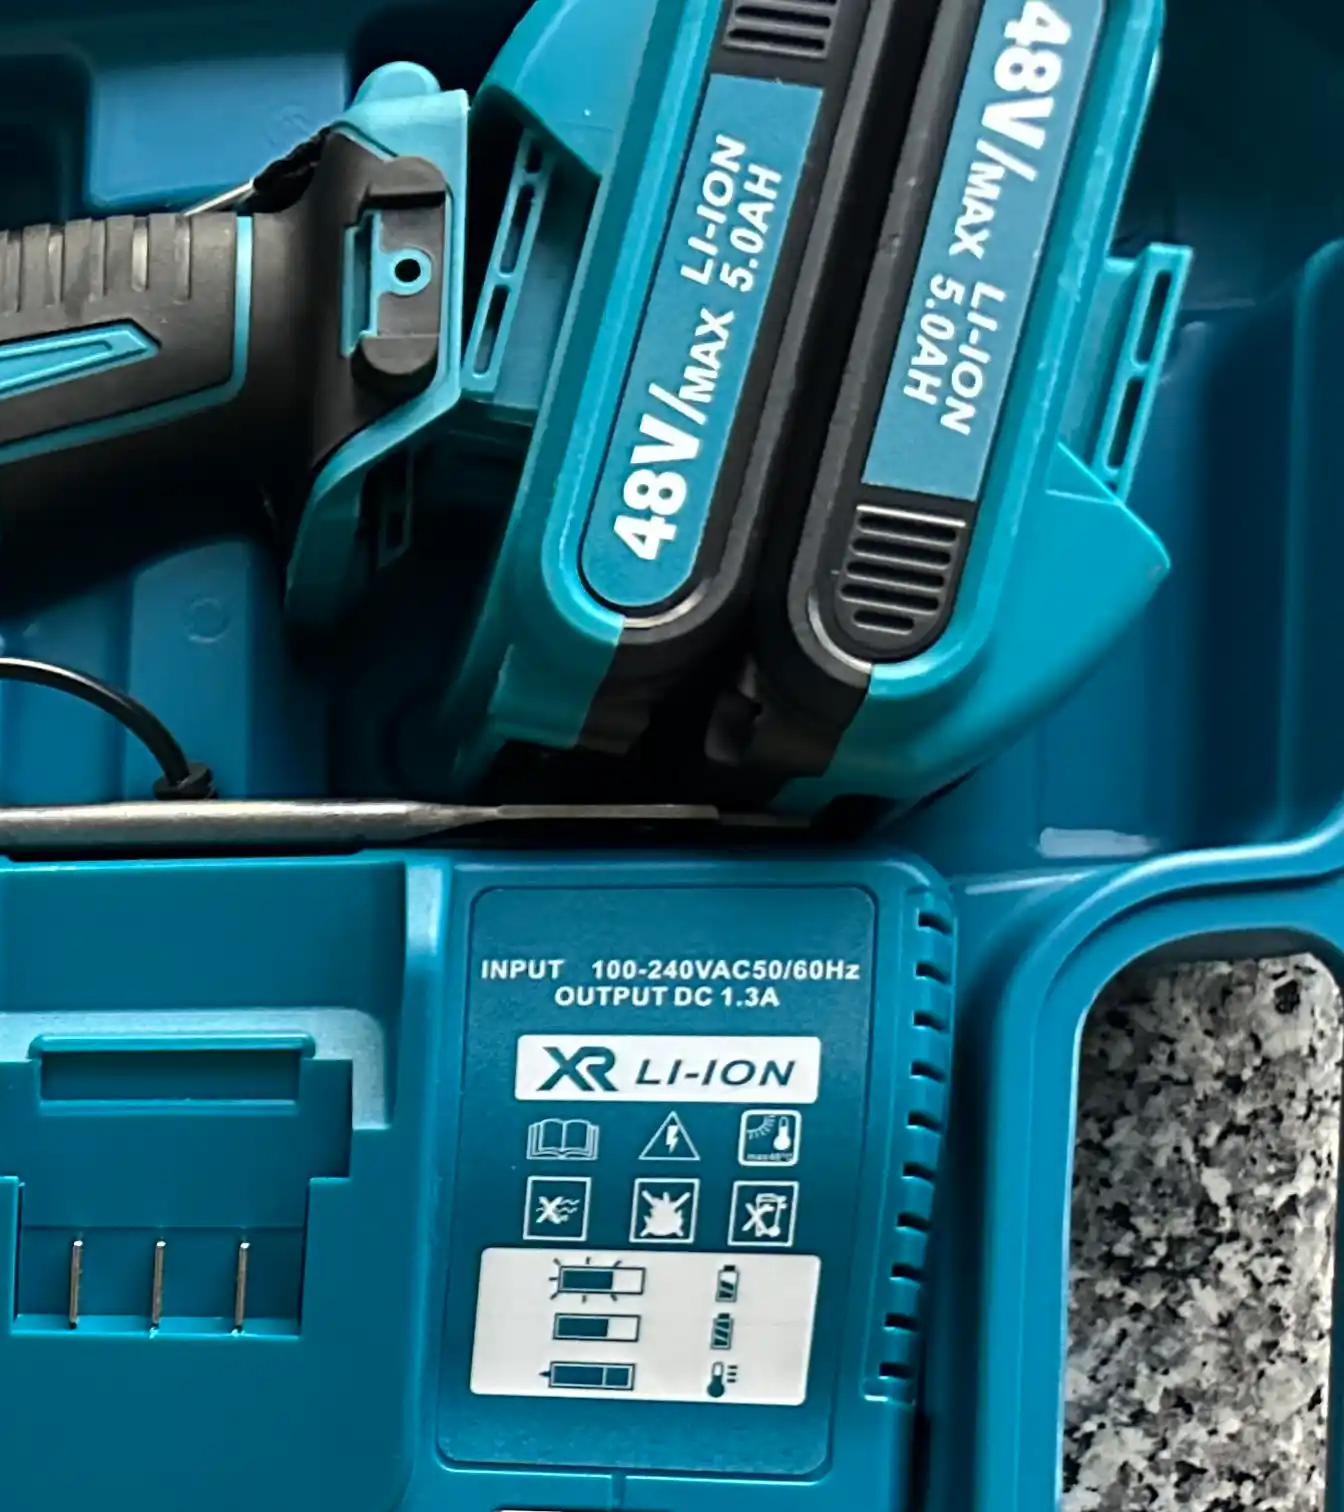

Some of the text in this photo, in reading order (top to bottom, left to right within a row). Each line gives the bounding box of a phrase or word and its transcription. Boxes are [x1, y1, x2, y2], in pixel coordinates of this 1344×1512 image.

[680, 135, 748, 286] LI-ION
[721, 166, 783, 292] 5.0AH
[903, 274, 960, 406] 5.0AH
[940, 281, 1006, 435] LI-ION
[613, 308, 736, 561] 48V/MAX
[480, 959, 861, 981] INPUT 100-240VAC50/60Hz
[554, 986, 668, 1007] OUTPUT
[535, 1046, 795, 1092] XR LI-ION
